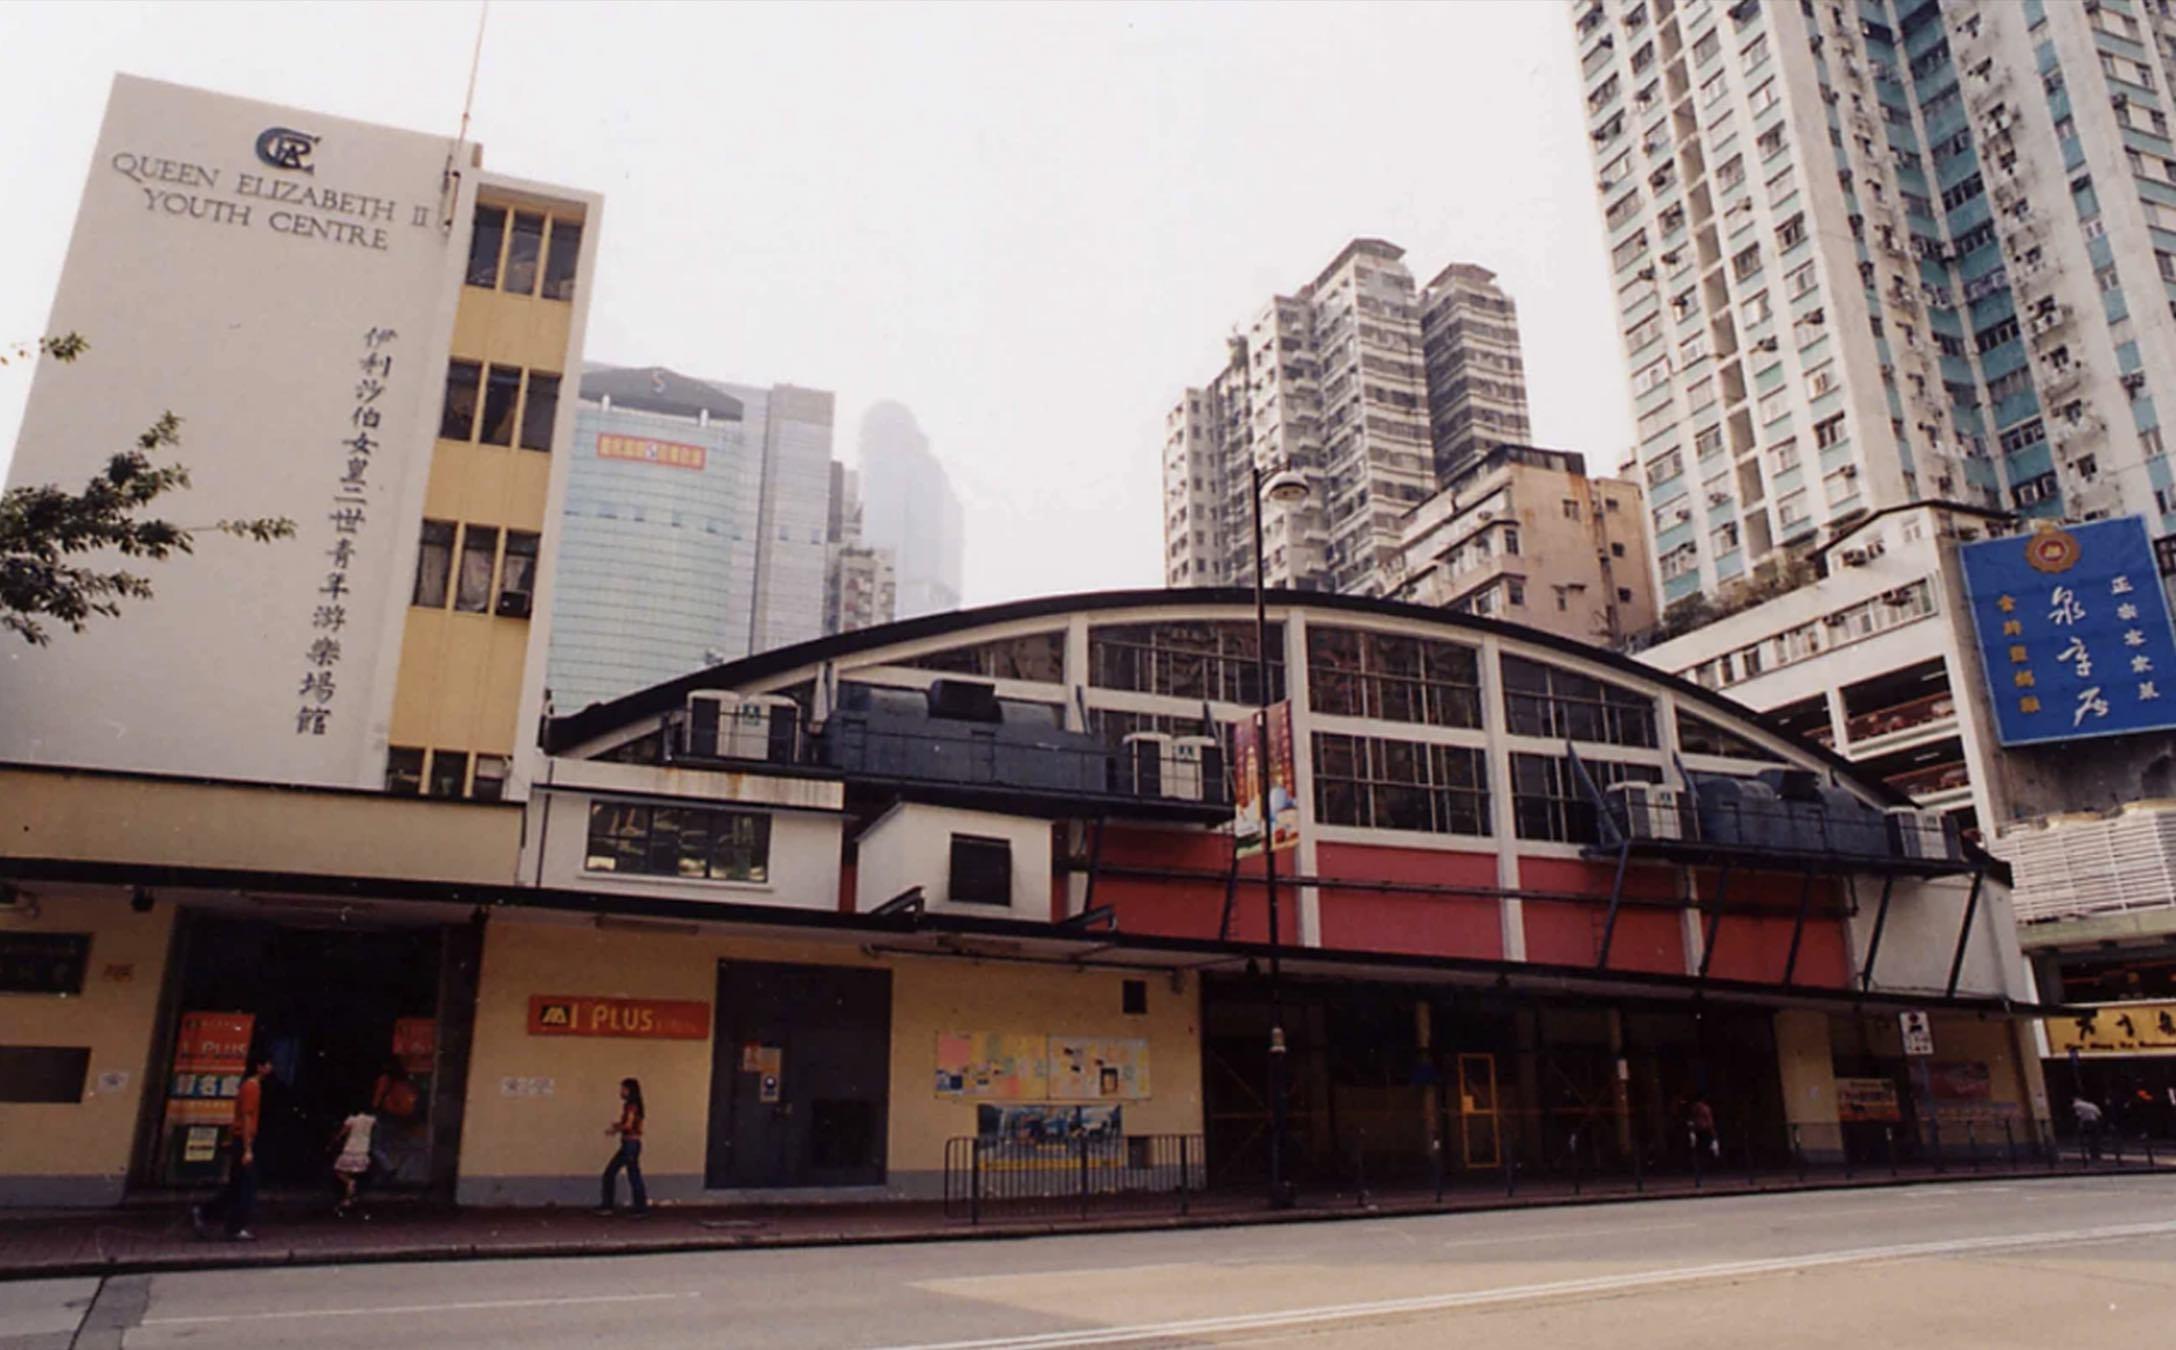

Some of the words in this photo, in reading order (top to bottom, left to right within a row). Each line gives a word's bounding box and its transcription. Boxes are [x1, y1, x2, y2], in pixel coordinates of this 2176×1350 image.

[112, 152, 220, 188] QUEEN
[235, 172, 397, 222] ELIZABETH
[411, 205, 431, 228] II
[143, 187, 252, 227] YOUTH
[268, 210, 389, 251] CENTRE
[592, 1004, 653, 1031] PLUS
